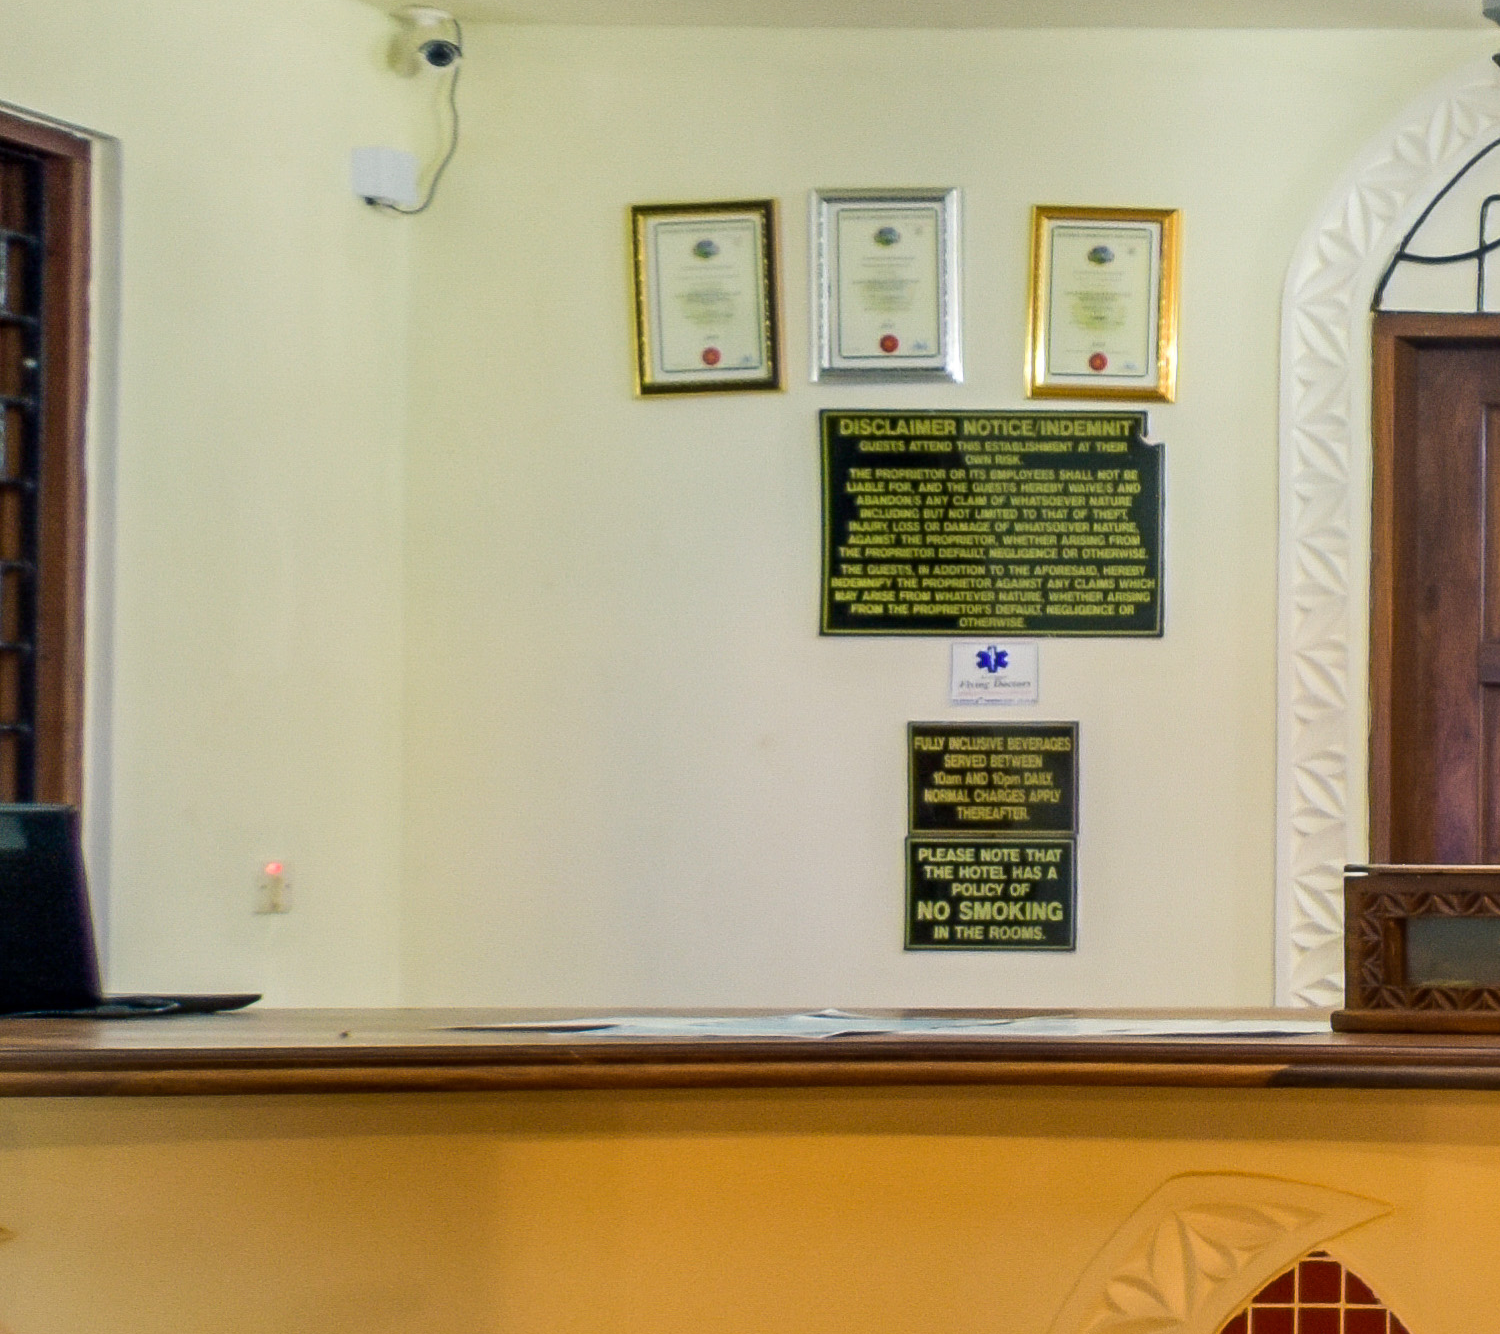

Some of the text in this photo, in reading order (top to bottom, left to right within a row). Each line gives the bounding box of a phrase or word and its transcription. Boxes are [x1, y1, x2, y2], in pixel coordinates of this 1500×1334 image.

[840, 419, 957, 436] DISCLAIMER
[909, 441, 952, 452] ATTEND
[957, 441, 981, 452] THIS
[985, 441, 1073, 452] ESTABLISHMENT
[1078, 441, 1090, 452] AT
[1096, 441, 1128, 452] THEIR
[965, 454, 992, 466] OWN
[850, 469, 1138, 480] THE PROPRIETOR OR ITS EMPLOYEES SHALL NOT BE
[847, 482, 885, 493] LIABLE
[919, 482, 943, 493] AND
[946, 482, 968, 493] THE
[1021, 482, 1064, 493] HEREBY
[1117, 482, 1142, 493] AND
[926, 495, 949, 506] ANY
[953, 495, 987, 506] CLAIM
[990, 495, 1006, 506] OF
[1011, 495, 1086, 506] WHATSOEVER
[1089, 495, 1132, 506] NATURE
[860, 508, 920, 519] INCLUDING
[923, 508, 946, 519] BUT
[949, 508, 970, 519] NOT
[975, 508, 1018, 519] LIMITED
[1023, 508, 1037, 519] TO
[1043, 508, 1068, 519] THAT
[1072, 508, 1088, 519] OF
[892, 521, 921, 532] LOSS
[924, 521, 940, 532] OR
[943, 521, 990, 532] DAMAGE
[994, 521, 1009, 532] OF
[1013, 521, 1090, 532] WHATSOEVER
[848, 534, 896, 545] AGAINST
[901, 534, 923, 545] THE
[1003, 534, 1058, 545] WHETHER
[1061, 534, 1106, 545] ARISING
[1109, 534, 1141, 545] FROM
[839, 547, 862, 558] THE
[865, 547, 936, 558] PROPRIETOR
[989, 547, 1059, 558] NEGLIGENCE
[1063, 547, 1079, 558] OR
[841, 565, 863, 575] THE
[918, 565, 930, 575] IN
[933, 565, 986, 575] ADDITION
[990, 565, 1005, 575] TO
[1009, 565, 1030, 575] THE
[1103, 565, 1146, 575] HEREBY
[897, 577, 918, 588] THE
[922, 577, 992, 588] PROPRIETOR
[995, 577, 1042, 588] AGAINST
[1047, 577, 1071, 588] ANY
[1074, 577, 1116, 588] CLAIMS
[1119, 577, 1155, 588] WHICH
[861, 590, 896, 601] ARISE
[900, 590, 931, 601] FROM
[935, 590, 995, 601] WHATEVER
[1049, 590, 1103, 601] WHETHER
[1107, 590, 1150, 601] ARISING
[851, 604, 884, 615] FROM
[888, 604, 910, 615] THE
[1046, 604, 1115, 615] NEGLIGENCE
[1118, 604, 1135, 615] OR
[914, 736, 1072, 751] FULLY INCLUSIVE BEVERAGES
[944, 754, 1043, 768] SERVED BETWEEN
[933, 771, 962, 785] 10am
[965, 771, 989, 785] AND
[992, 771, 1021, 788] 10pm
[924, 789, 1062, 803] NORMAL CHARGES APPLY
[918, 848, 1063, 862] PLEASE NOTE THAT
[924, 865, 1058, 880] THE HOTEL HAS A
[952, 882, 1031, 897] POLICY OF
[917, 902, 1064, 921] NO SMOKING
[934, 926, 1046, 940] IN THE ROOMS.
